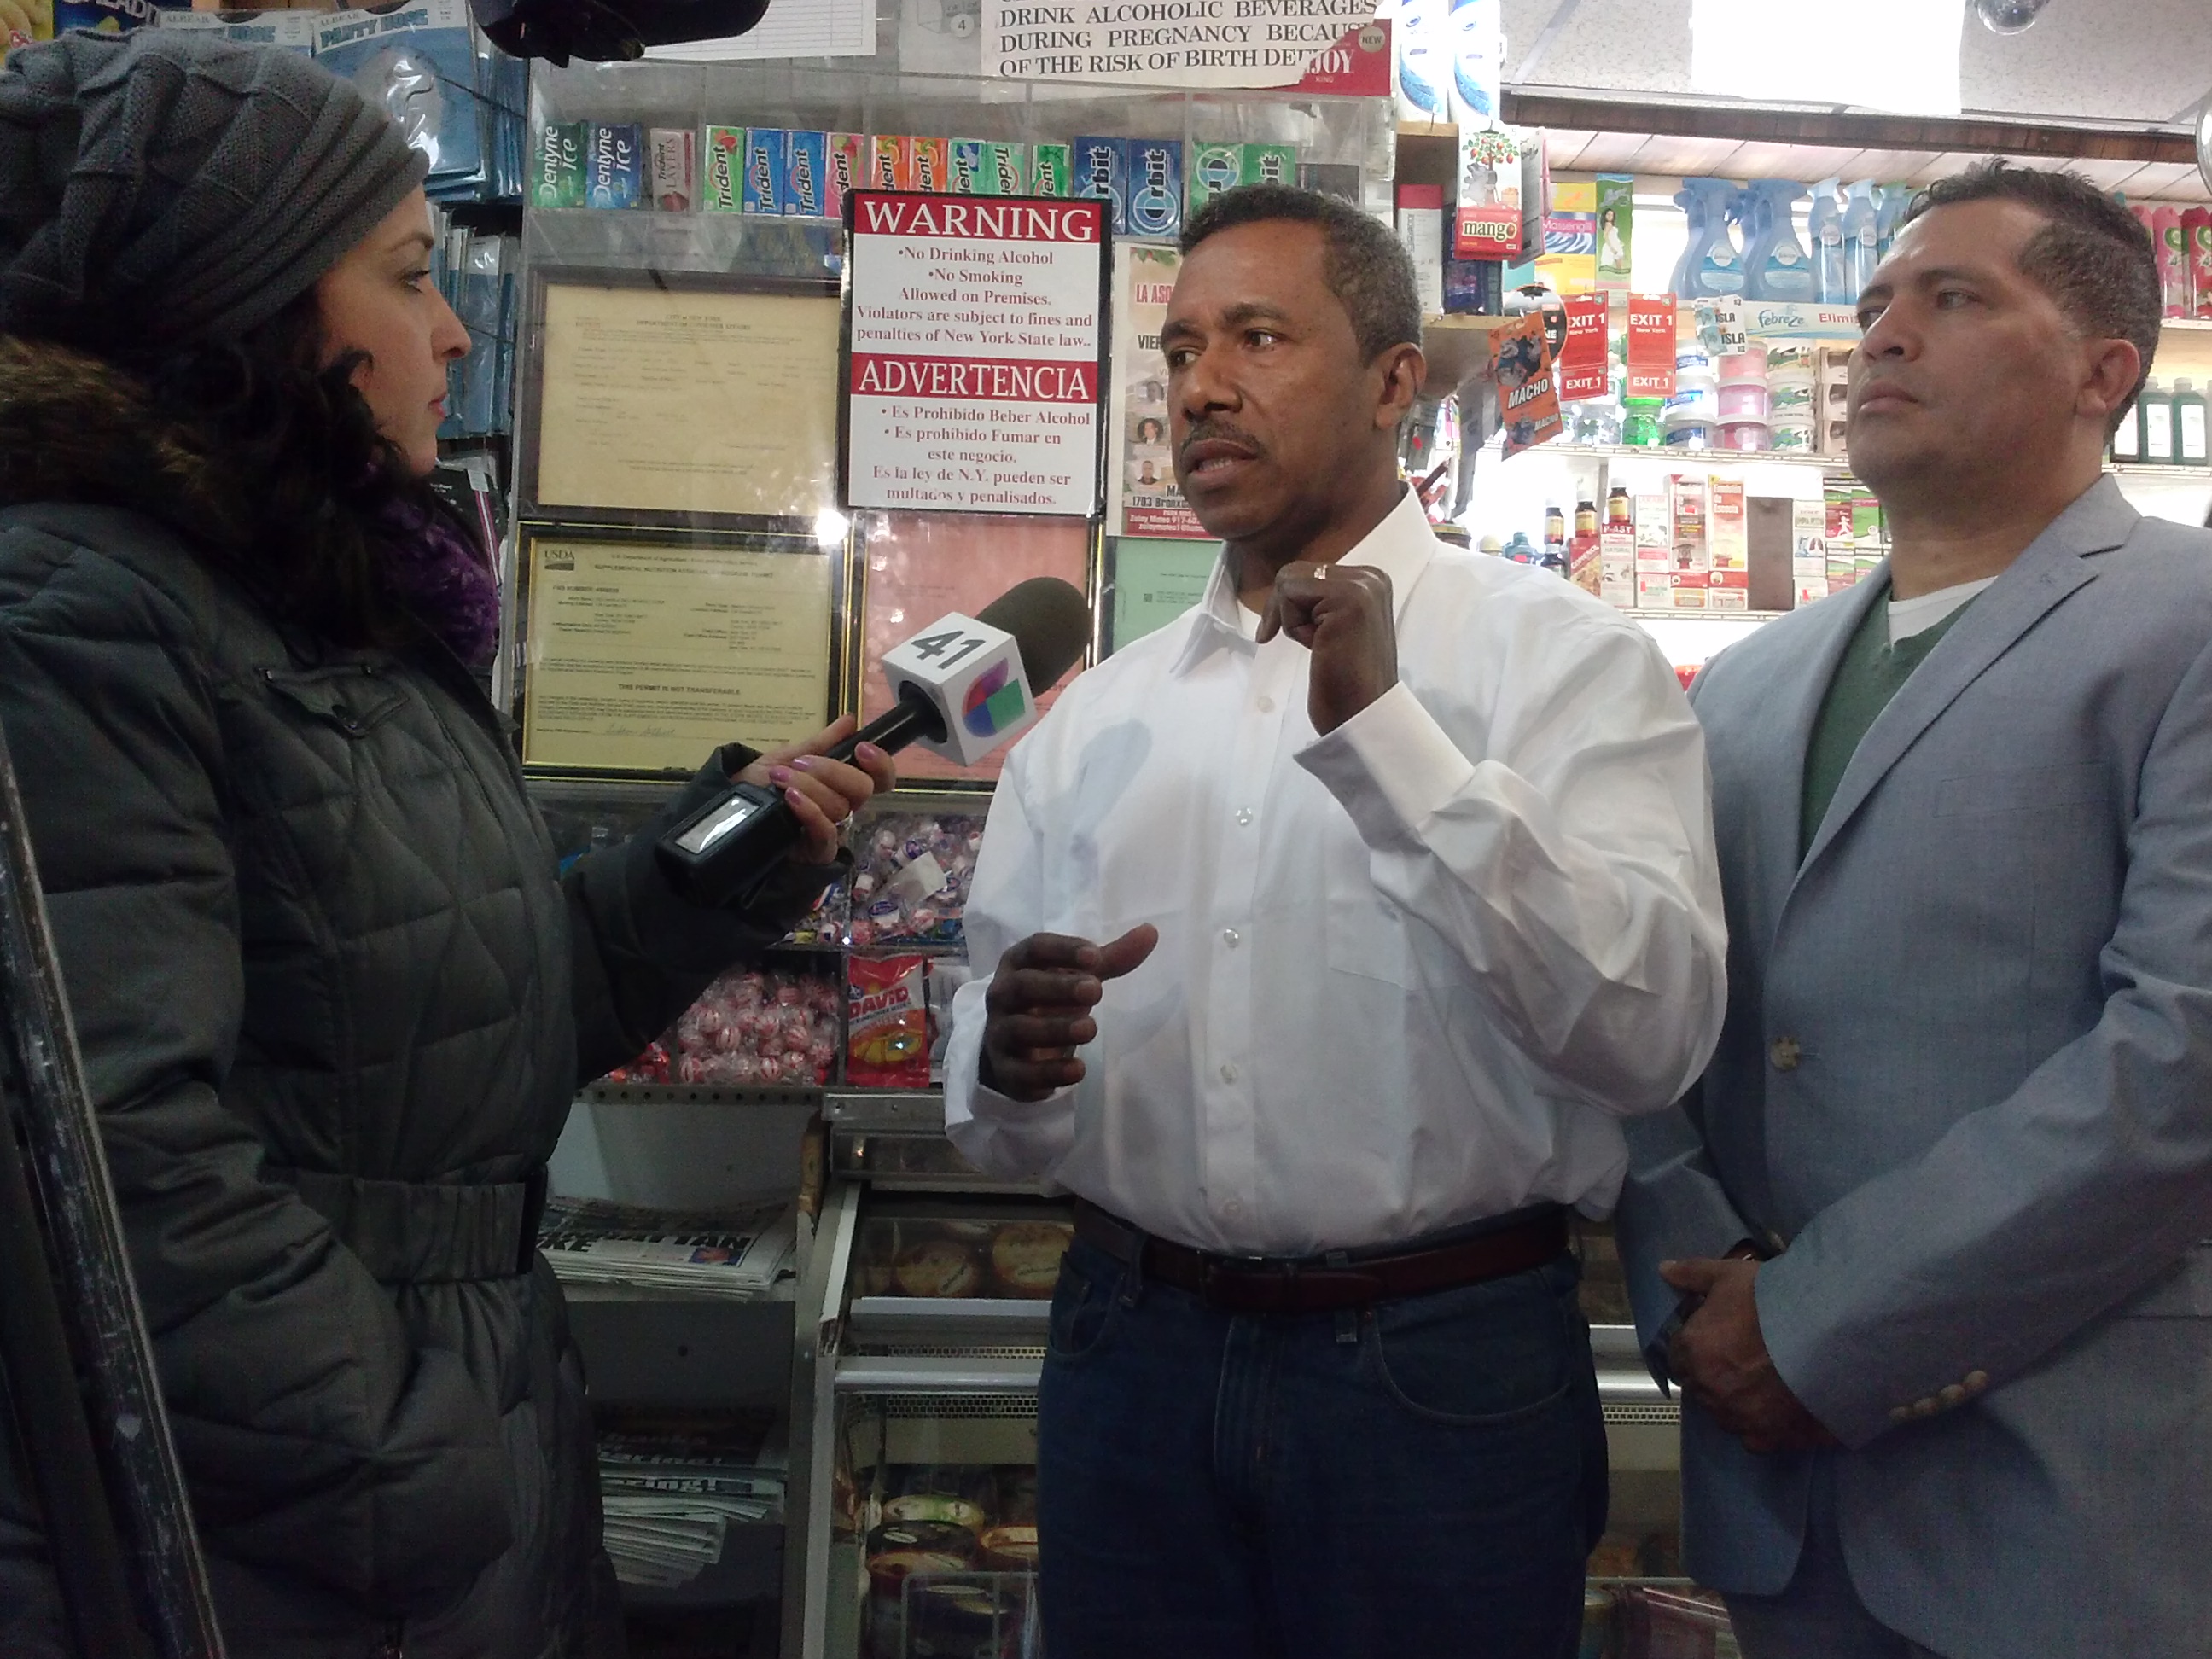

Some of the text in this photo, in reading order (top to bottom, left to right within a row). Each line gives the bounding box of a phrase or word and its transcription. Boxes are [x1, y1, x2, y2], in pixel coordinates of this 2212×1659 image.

[1000, 6, 1075, 28] DRINK
[1085, 2, 1224, 23] ALCOHOLIC
[1234, 0, 1377, 17] BEVERAGES
[1000, 31, 1092, 53] DURING
[1107, 24, 1253, 49] PREGNANCY
[1361, 36, 1382, 44] NEW
[999, 58, 1031, 77] OF
[1035, 55, 1083, 74] THE
[1088, 53, 1144, 73] RISK
[1148, 51, 1180, 70] OF
[1184, 49, 1258, 67] BIRTH
[1307, 49, 1355, 74] JOY
[539, 125, 562, 199] Dentyne
[594, 127, 615, 201] Dentyne
[658, 143, 667, 180] Trident
[666, 137, 678, 189] LAYERS
[1090, 146, 1111, 197] rbit
[713, 146, 733, 209] Trident
[754, 148, 776, 211] Trident
[795, 148, 817, 212] Trident
[864, 201, 1093, 242] WARNING
[1463, 220, 1516, 242] mango
[929, 247, 995, 265] Drinking
[998, 250, 1054, 265] Alcohol
[959, 269, 1023, 288] Smoking
[899, 288, 1052, 306] Allowed on Premises.
[1137, 284, 1172, 304] LA ASO
[857, 306, 1093, 328] Violators are subject to fines and
[1598, 312, 1606, 325] 1
[1630, 313, 1673, 326] EXIT 1
[1714, 312, 1736, 323] ISLA
[1758, 309, 1805, 329] Febreze
[857, 327, 922, 341] penalties
[926, 328, 941, 341] of
[944, 329, 975, 342] New
[979, 330, 1015, 345] York
[1018, 331, 1055, 346] State
[1721, 332, 1746, 345] ISLA
[859, 359, 1090, 399] ADVERTENCIA
[1566, 377, 1593, 390] EXIT
[1633, 376, 1661, 387] EXIT
[1506, 377, 1549, 410] MACHO
[892, 405, 1091, 425] Es Prohibido Beber Alcohol
[894, 425, 1062, 445] Es prohibido Fumar en
[927, 449, 1018, 464] este negocio.
[872, 466, 1072, 486] Es la ley de N.Y. pueden ser
[886, 487, 1057, 505] multados y penalisados.
[1132, 496, 1152, 507] 1703
[544, 550, 575, 561] USDA
[911, 630, 986, 670] 41
[848, 986, 909, 1019] DAVID
